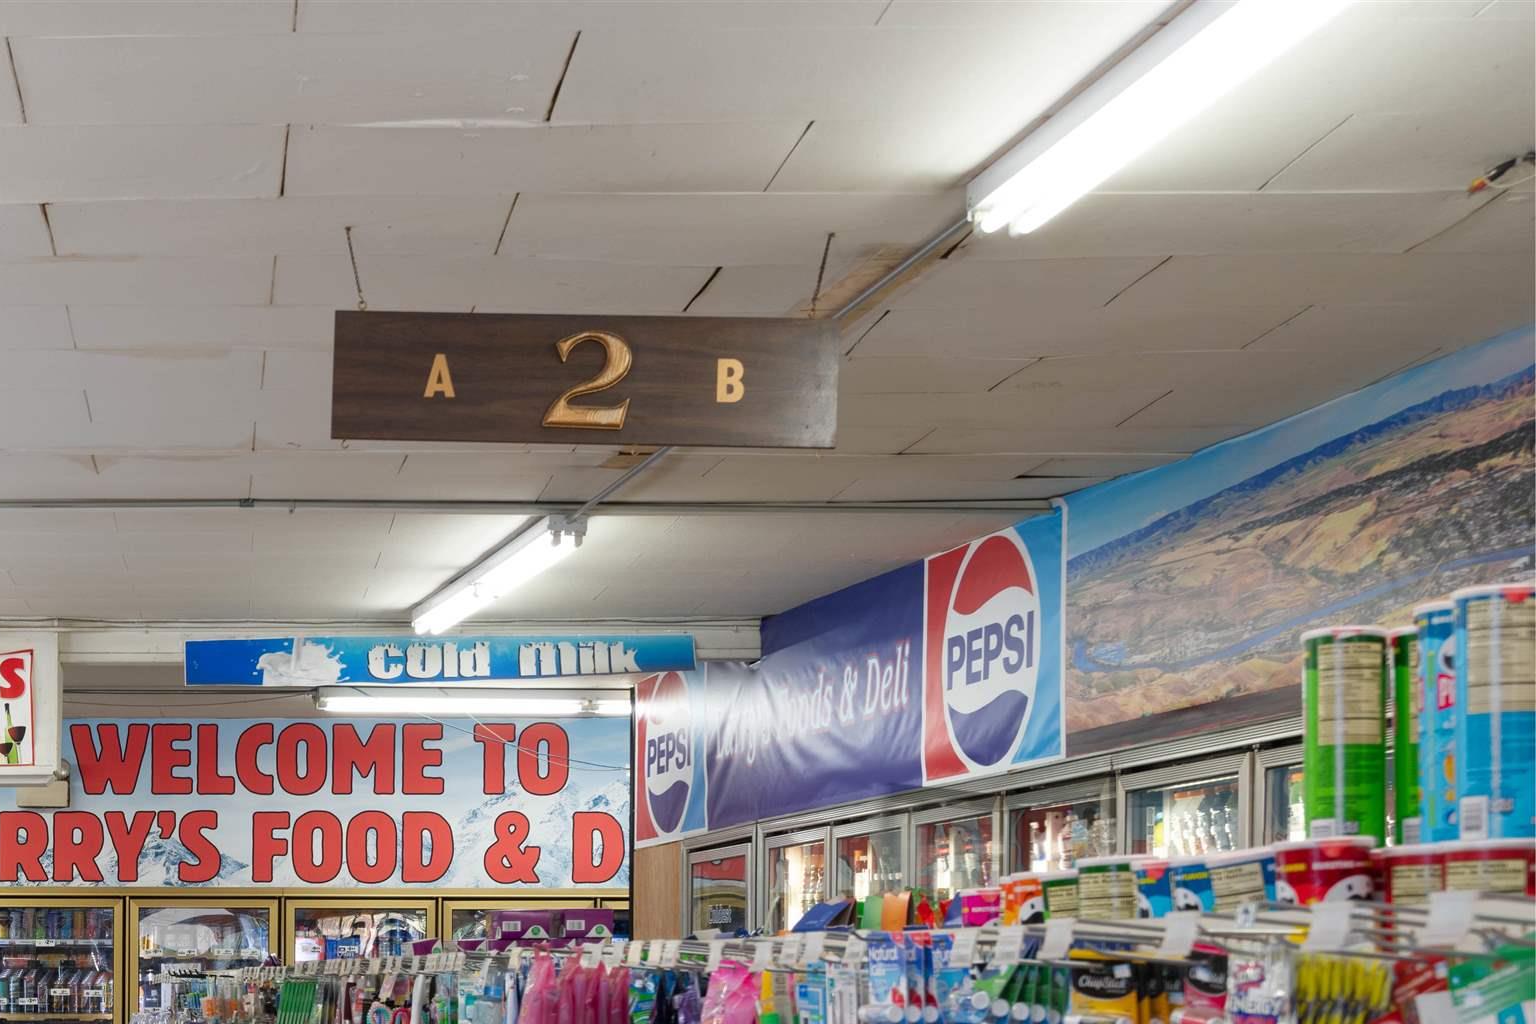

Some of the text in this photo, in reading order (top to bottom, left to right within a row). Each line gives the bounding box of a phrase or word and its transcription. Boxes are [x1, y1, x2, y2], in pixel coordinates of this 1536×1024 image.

[424, 329, 744, 430] A 2 B
[368, 640, 640, 680] cold milk
[864, 643, 910, 715] Deli
[947, 610, 1034, 690] PEPSI
[71, 723, 570, 797] WELCOME TO
[647, 719, 691, 777] PEPSI
[252, 811, 455, 884] FOOD
[484, 811, 541, 884] &
